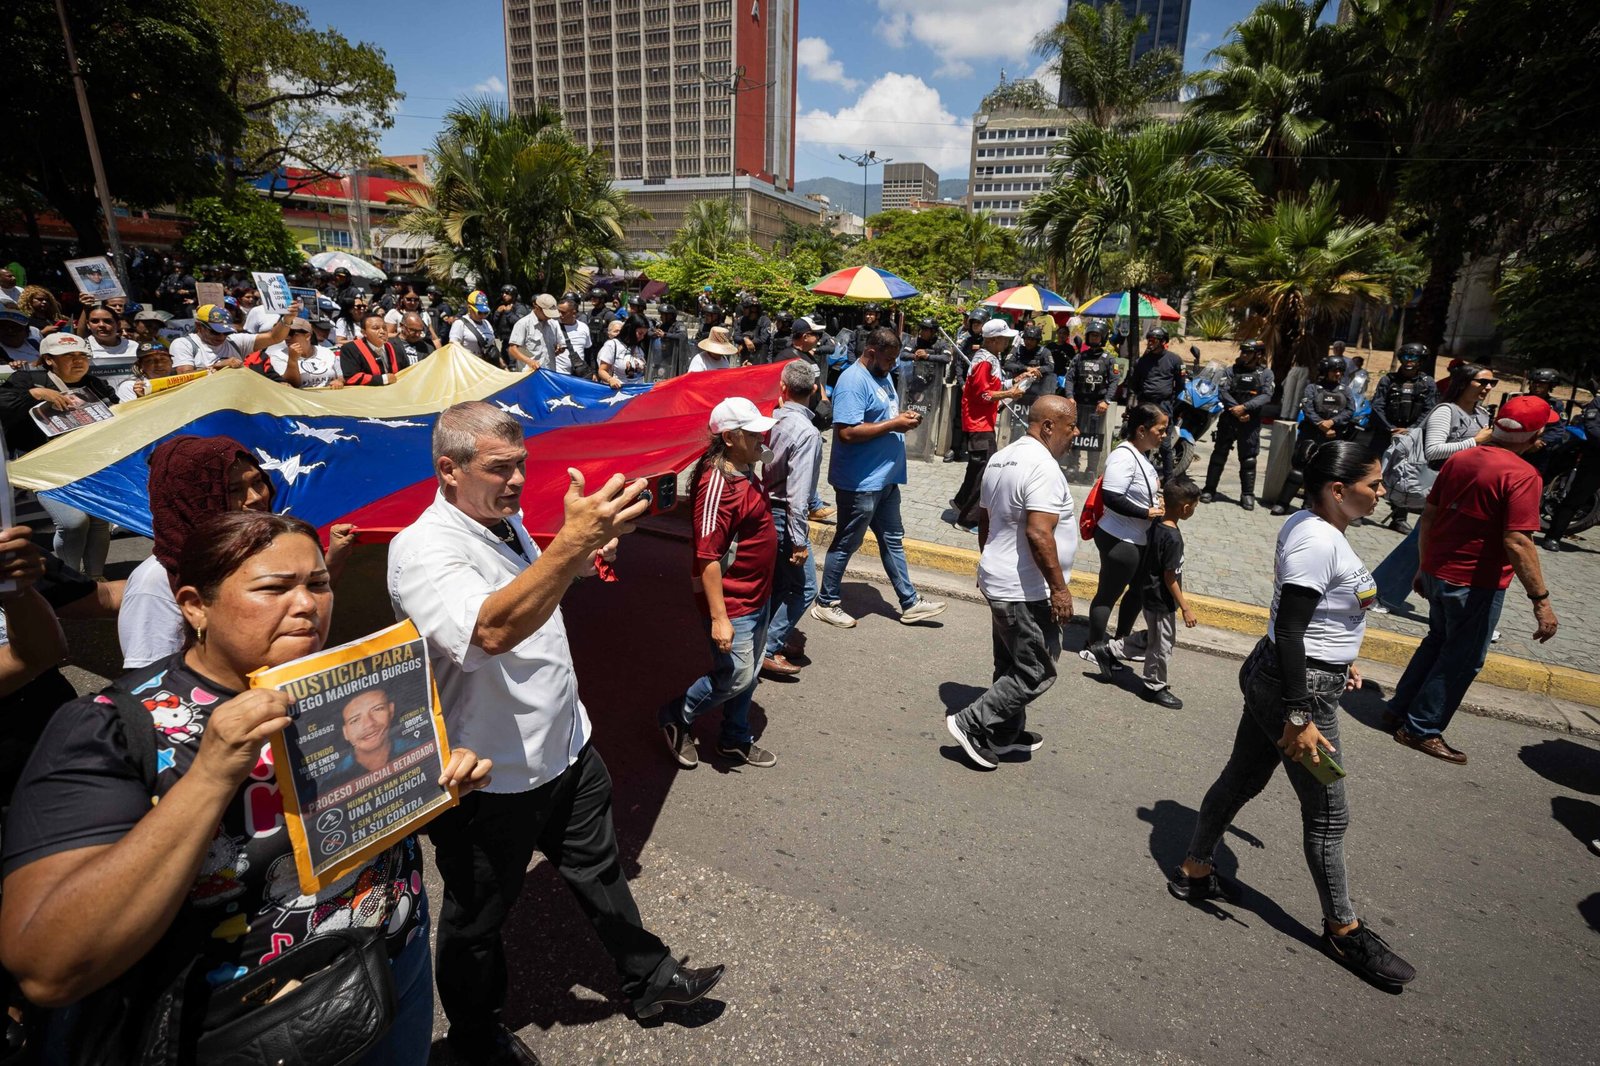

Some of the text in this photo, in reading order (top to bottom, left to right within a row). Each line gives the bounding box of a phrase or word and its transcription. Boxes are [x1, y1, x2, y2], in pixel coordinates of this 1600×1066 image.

[1013, 403, 1030, 416] PN
[1072, 436, 1099, 448] LICÍA
[371, 644, 414, 672] PARA
[325, 672, 380, 703] MAURICIO
[381, 657, 422, 681] BURGOS
[307, 723, 317, 733] CC
[308, 762, 318, 772] DE
[318, 752, 340, 767] ENERO
[319, 762, 336, 775] 2015
[308, 743, 434, 815] PROCESO JUDICIAL RETARDADO
[346, 766, 421, 810] NUNCA LE HAN HECHO
[348, 772, 427, 821] UNA AUDIENCIA
[350, 799, 404, 832] Y SIN PRUEBAS
[352, 796, 424, 843] EN SU CONTRA
